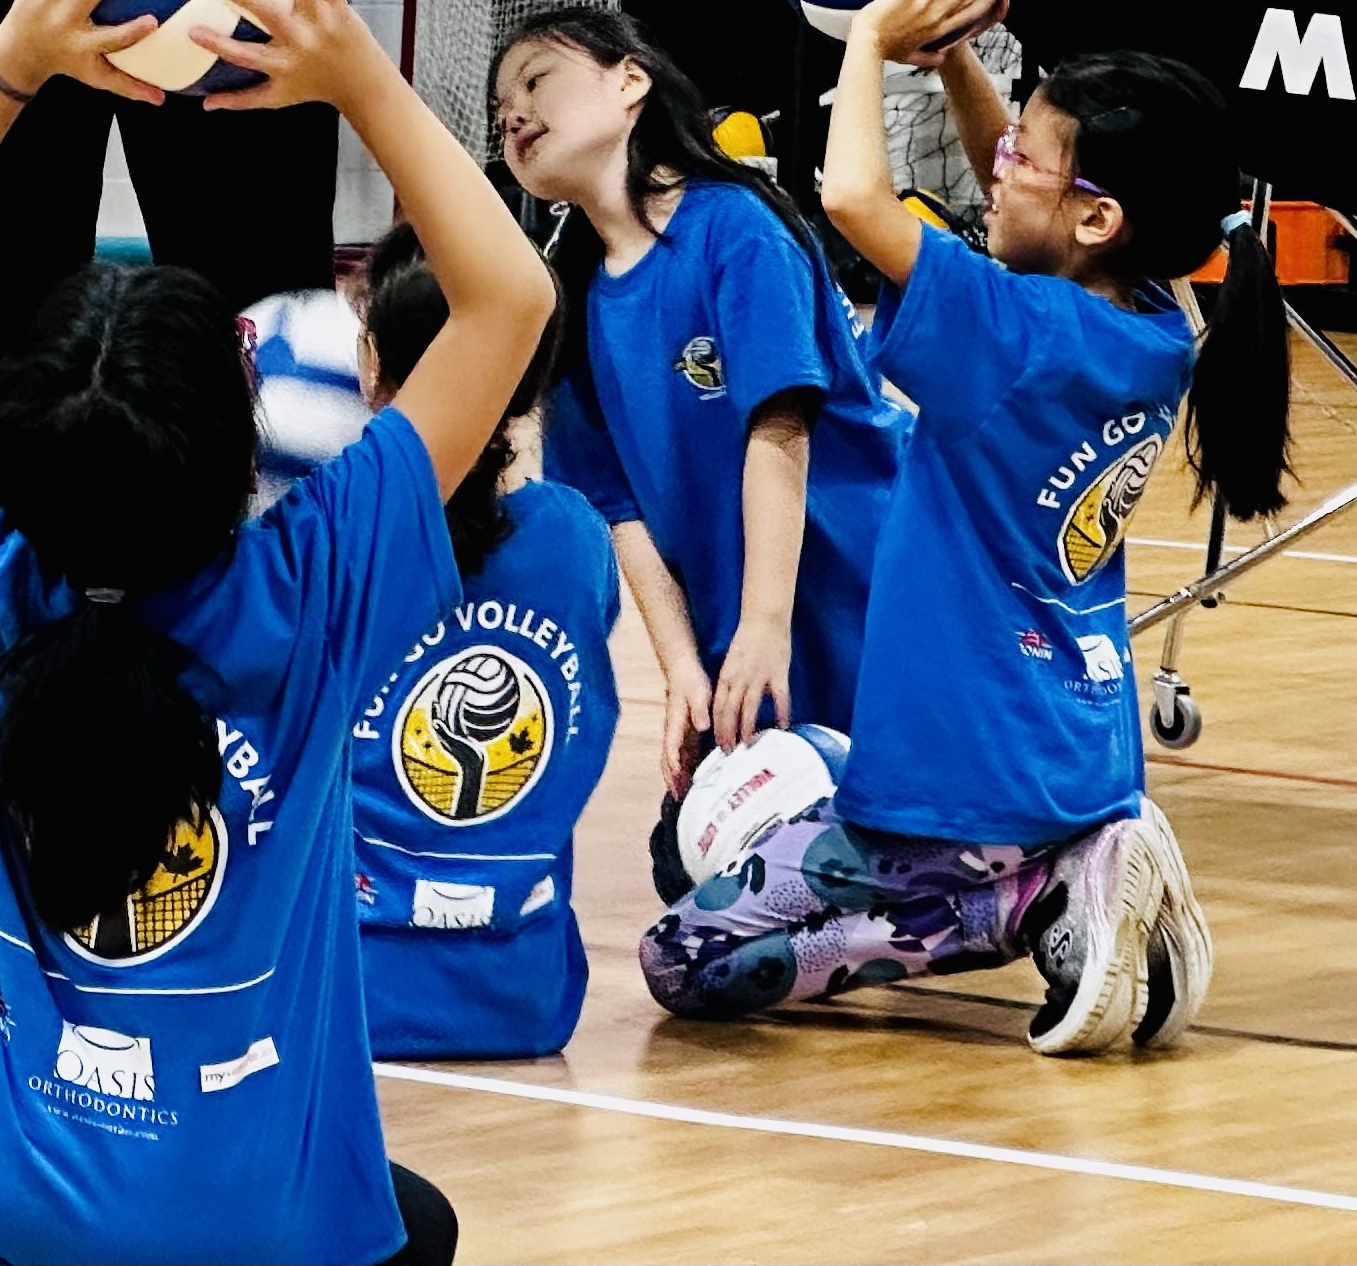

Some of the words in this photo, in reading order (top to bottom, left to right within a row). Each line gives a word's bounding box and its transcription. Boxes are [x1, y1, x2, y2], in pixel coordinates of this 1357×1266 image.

[1037, 441, 1097, 509] FUN
[1103, 411, 1146, 446] GO
[28, 1075, 179, 1126] ORTHODONTICS
[55, 1050, 155, 1101] OASIS
